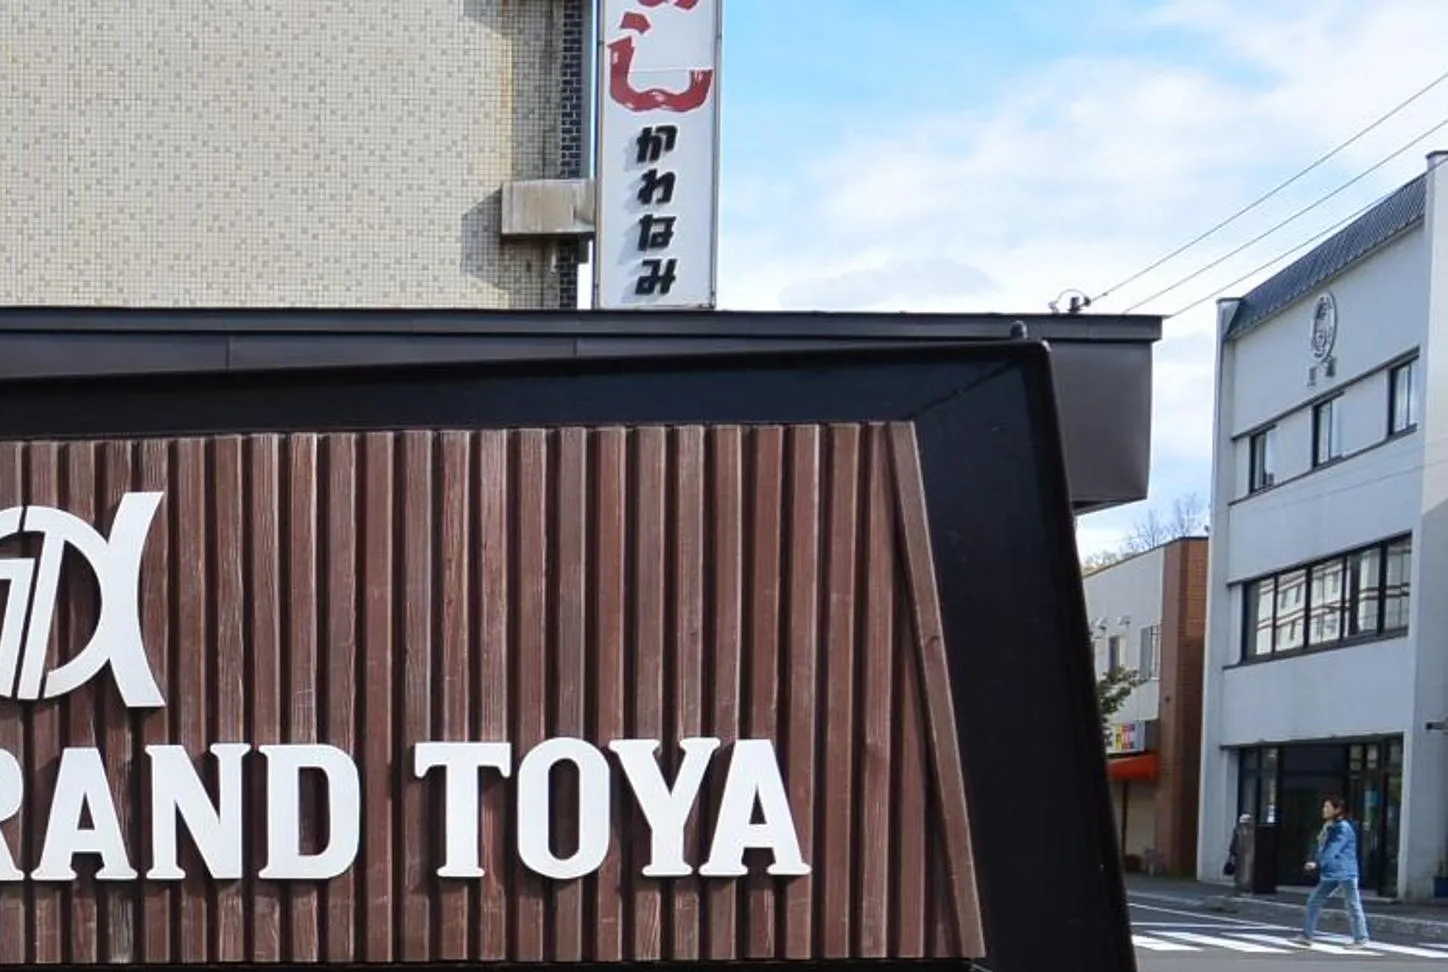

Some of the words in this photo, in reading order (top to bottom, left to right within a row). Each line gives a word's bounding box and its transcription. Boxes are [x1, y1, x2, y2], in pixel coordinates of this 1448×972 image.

[634, 125, 678, 297] かわなみ
[414, 737, 812, 879] TOYA
